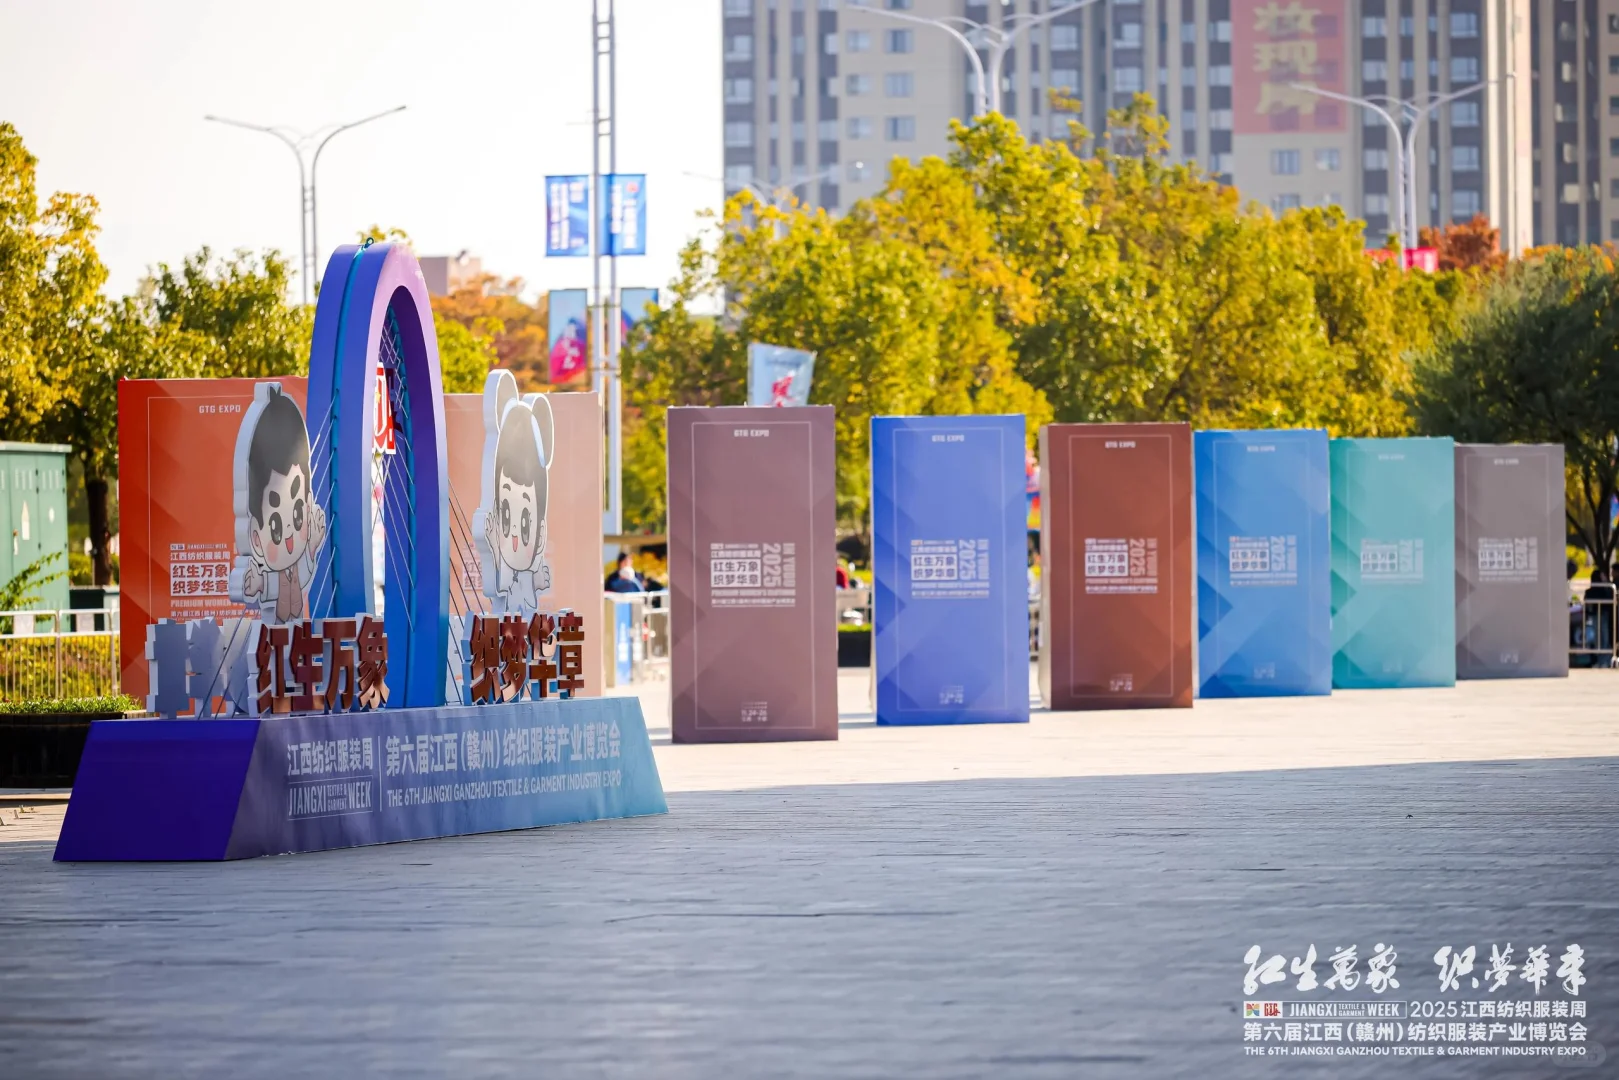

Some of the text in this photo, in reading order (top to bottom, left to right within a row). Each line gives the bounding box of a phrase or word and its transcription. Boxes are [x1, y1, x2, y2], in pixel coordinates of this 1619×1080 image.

[199, 405, 241, 414] GTG EXPO
[172, 564, 228, 578] 红生万象
[713, 561, 759, 572] 红生万象
[763, 543, 781, 587] 2025
[959, 539, 977, 580] 2025
[1130, 539, 1146, 576] 2025
[172, 580, 229, 594] 织梦华章
[713, 574, 759, 585] 织梦华章
[256, 616, 390, 713] 红生万象
[470, 612, 585, 703] 织梦华章
[287, 737, 373, 776] 江西纺织服装周
[288, 781, 372, 816] JIANGXI WEEK
[387, 770, 622, 808] THE 6TH JIANGXI GANZHOU TEXTILE & GARMENT INDUSTRY EXPO
